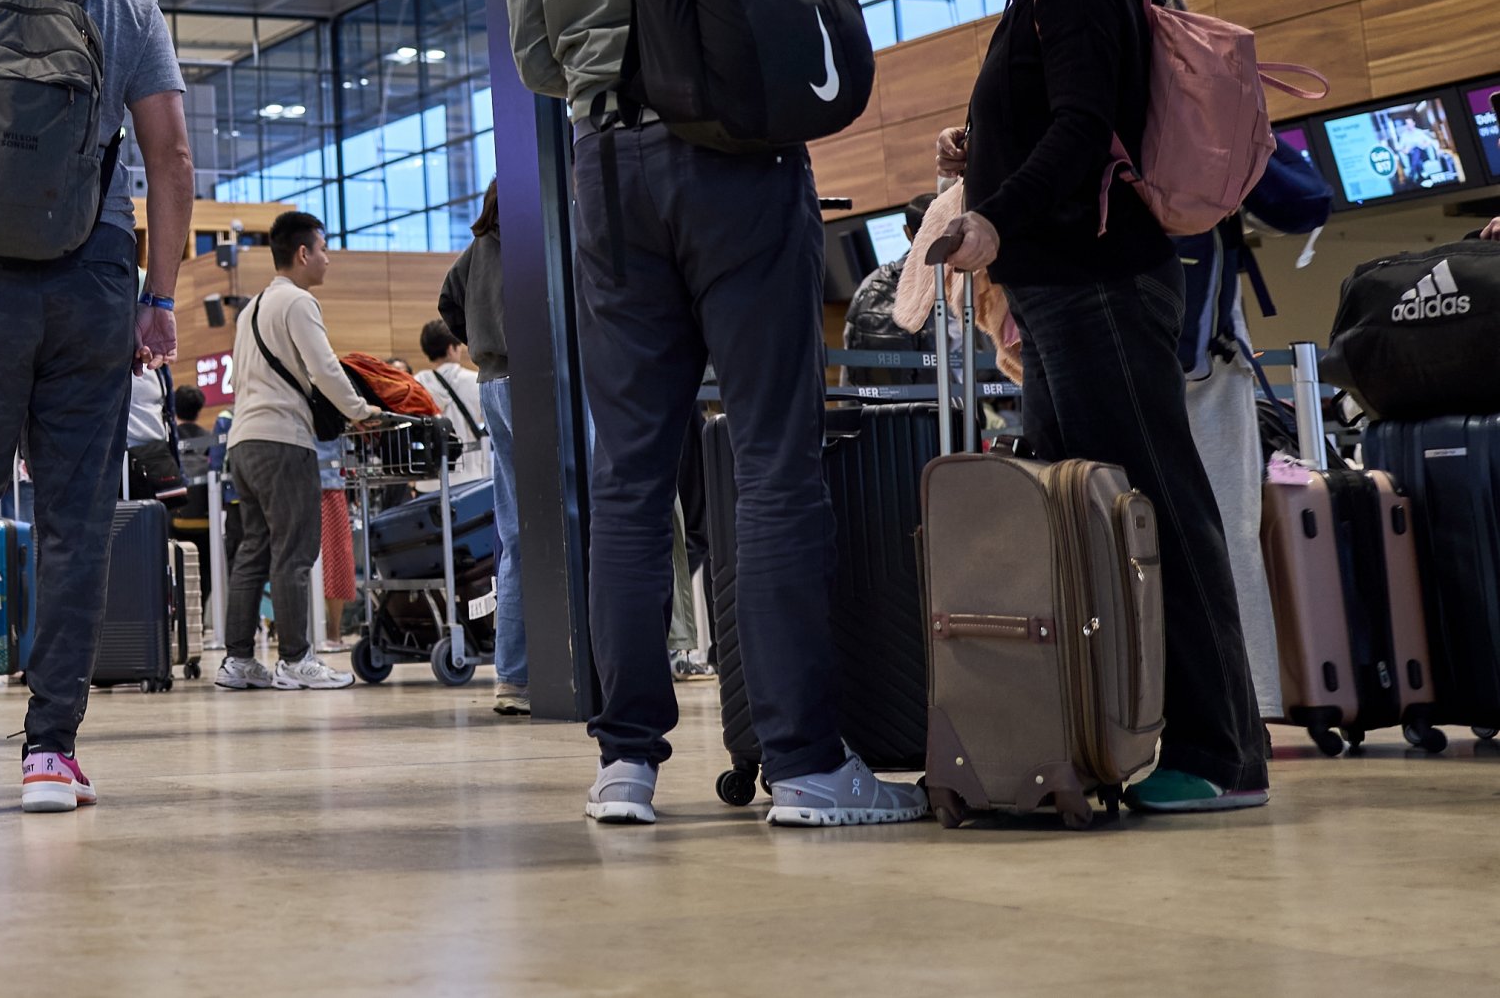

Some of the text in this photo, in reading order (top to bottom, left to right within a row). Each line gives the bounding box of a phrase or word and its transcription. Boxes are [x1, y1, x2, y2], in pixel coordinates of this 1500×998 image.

[3, 131, 39, 143] WILSON
[1391, 293, 1471, 322] adidas
[983, 383, 1004, 395] BER
